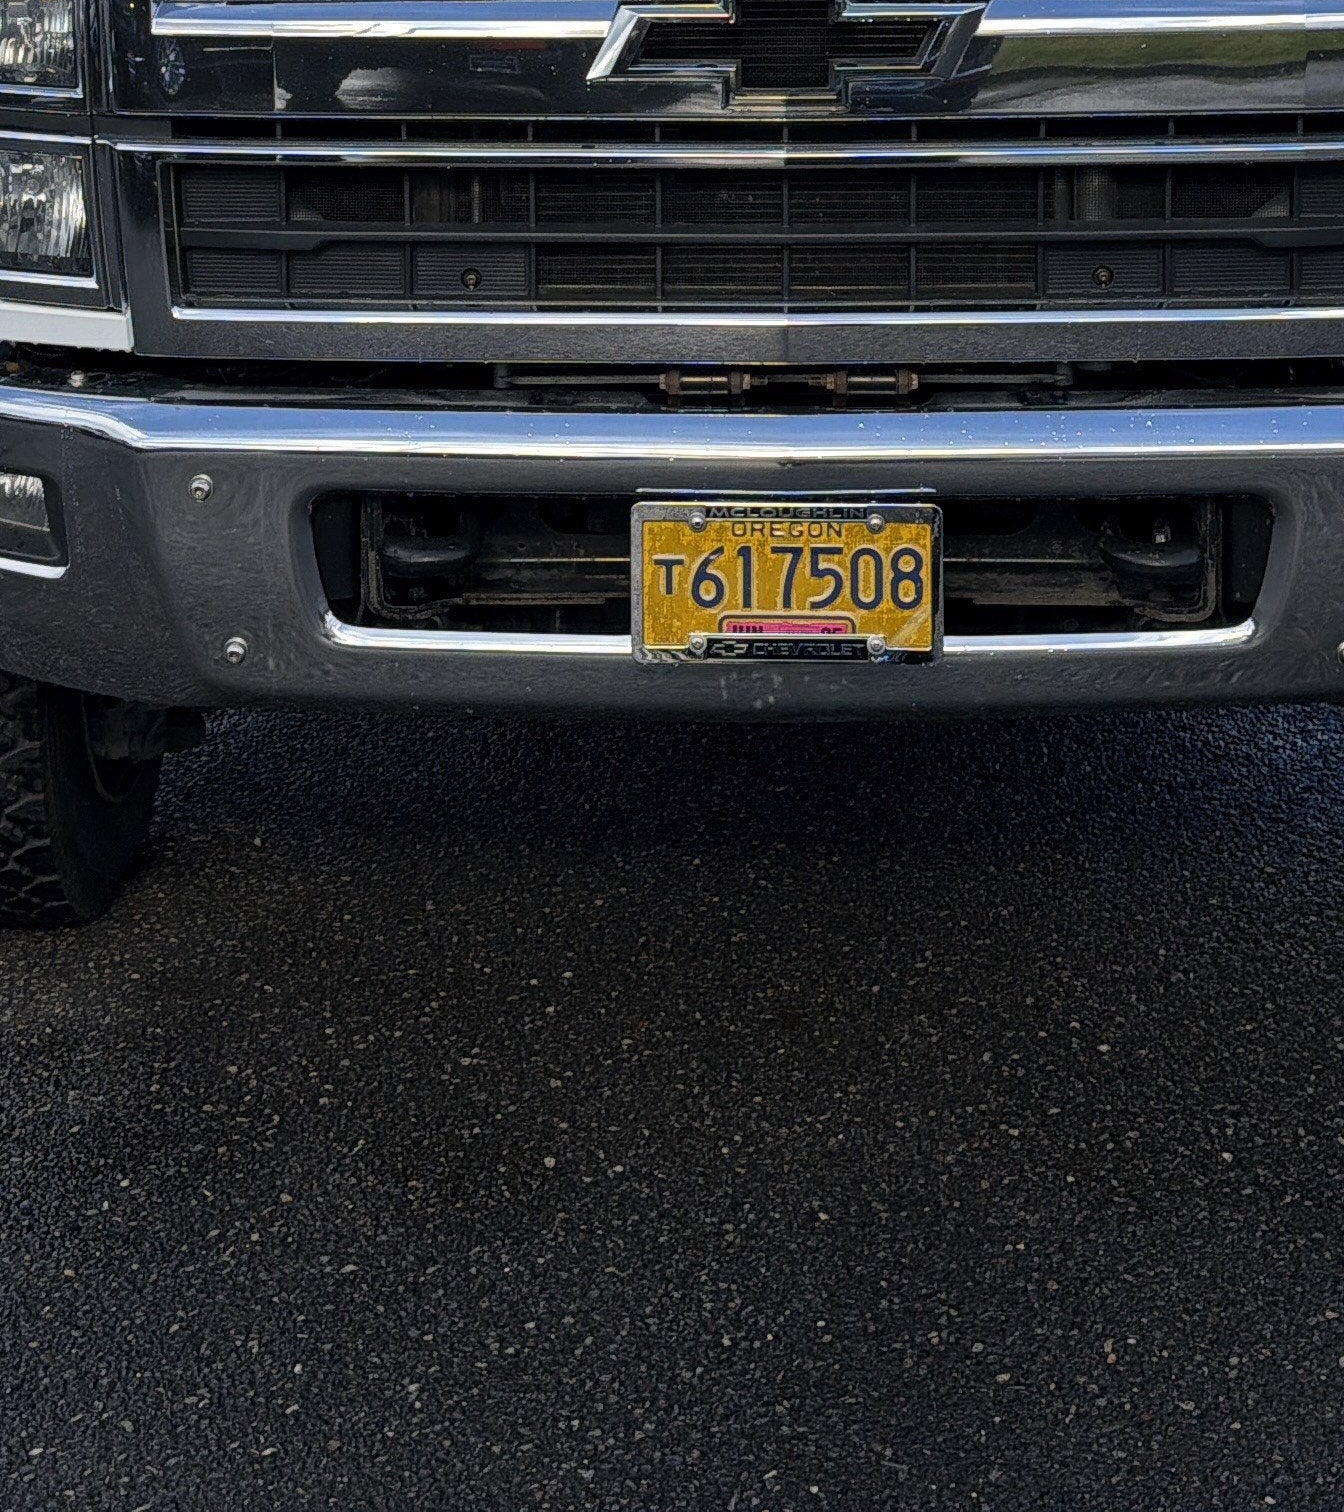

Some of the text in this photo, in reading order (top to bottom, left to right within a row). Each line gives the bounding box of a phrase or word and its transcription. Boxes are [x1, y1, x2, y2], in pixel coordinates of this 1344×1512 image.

[708, 506, 865, 519] MCLOUGHLIN
[731, 521, 843, 539] OREGON
[653, 545, 925, 611] T617508
[752, 642, 866, 656] CHEVROLET
